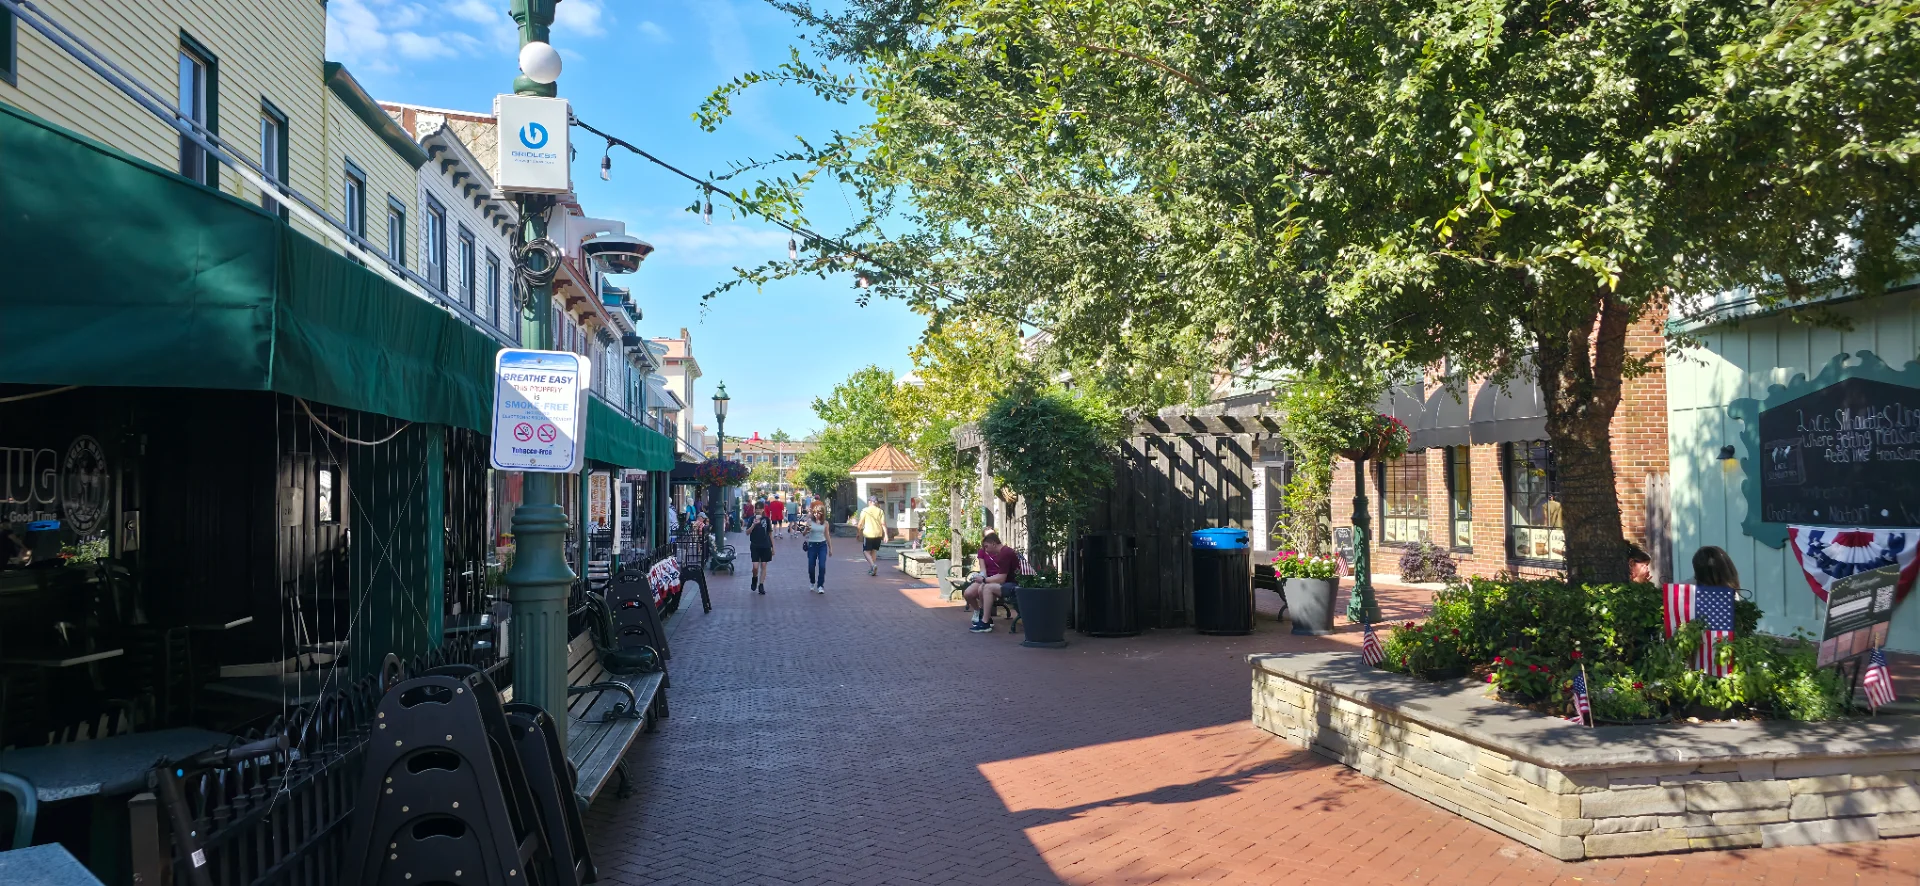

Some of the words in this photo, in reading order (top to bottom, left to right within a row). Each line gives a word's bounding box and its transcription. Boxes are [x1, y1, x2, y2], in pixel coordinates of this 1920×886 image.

[511, 151, 557, 159] GRIDLESS
[503, 373, 547, 383] BREATHE
[548, 375, 573, 384] EASY
[513, 384, 528, 392] THIS
[529, 385, 563, 393] PROPERTY
[533, 392, 540, 400] is
[504, 400, 569, 411] SMOKE-FREE
[1796, 408, 1831, 432] Lace
[1801, 433, 1834, 448] Where
[1836, 431, 1872, 451] getting
[1824, 448, 1850, 463] feels
[0, 446, 58, 504] UG
[9, 511, 34, 522] Good
[35, 511, 58, 522] Time
